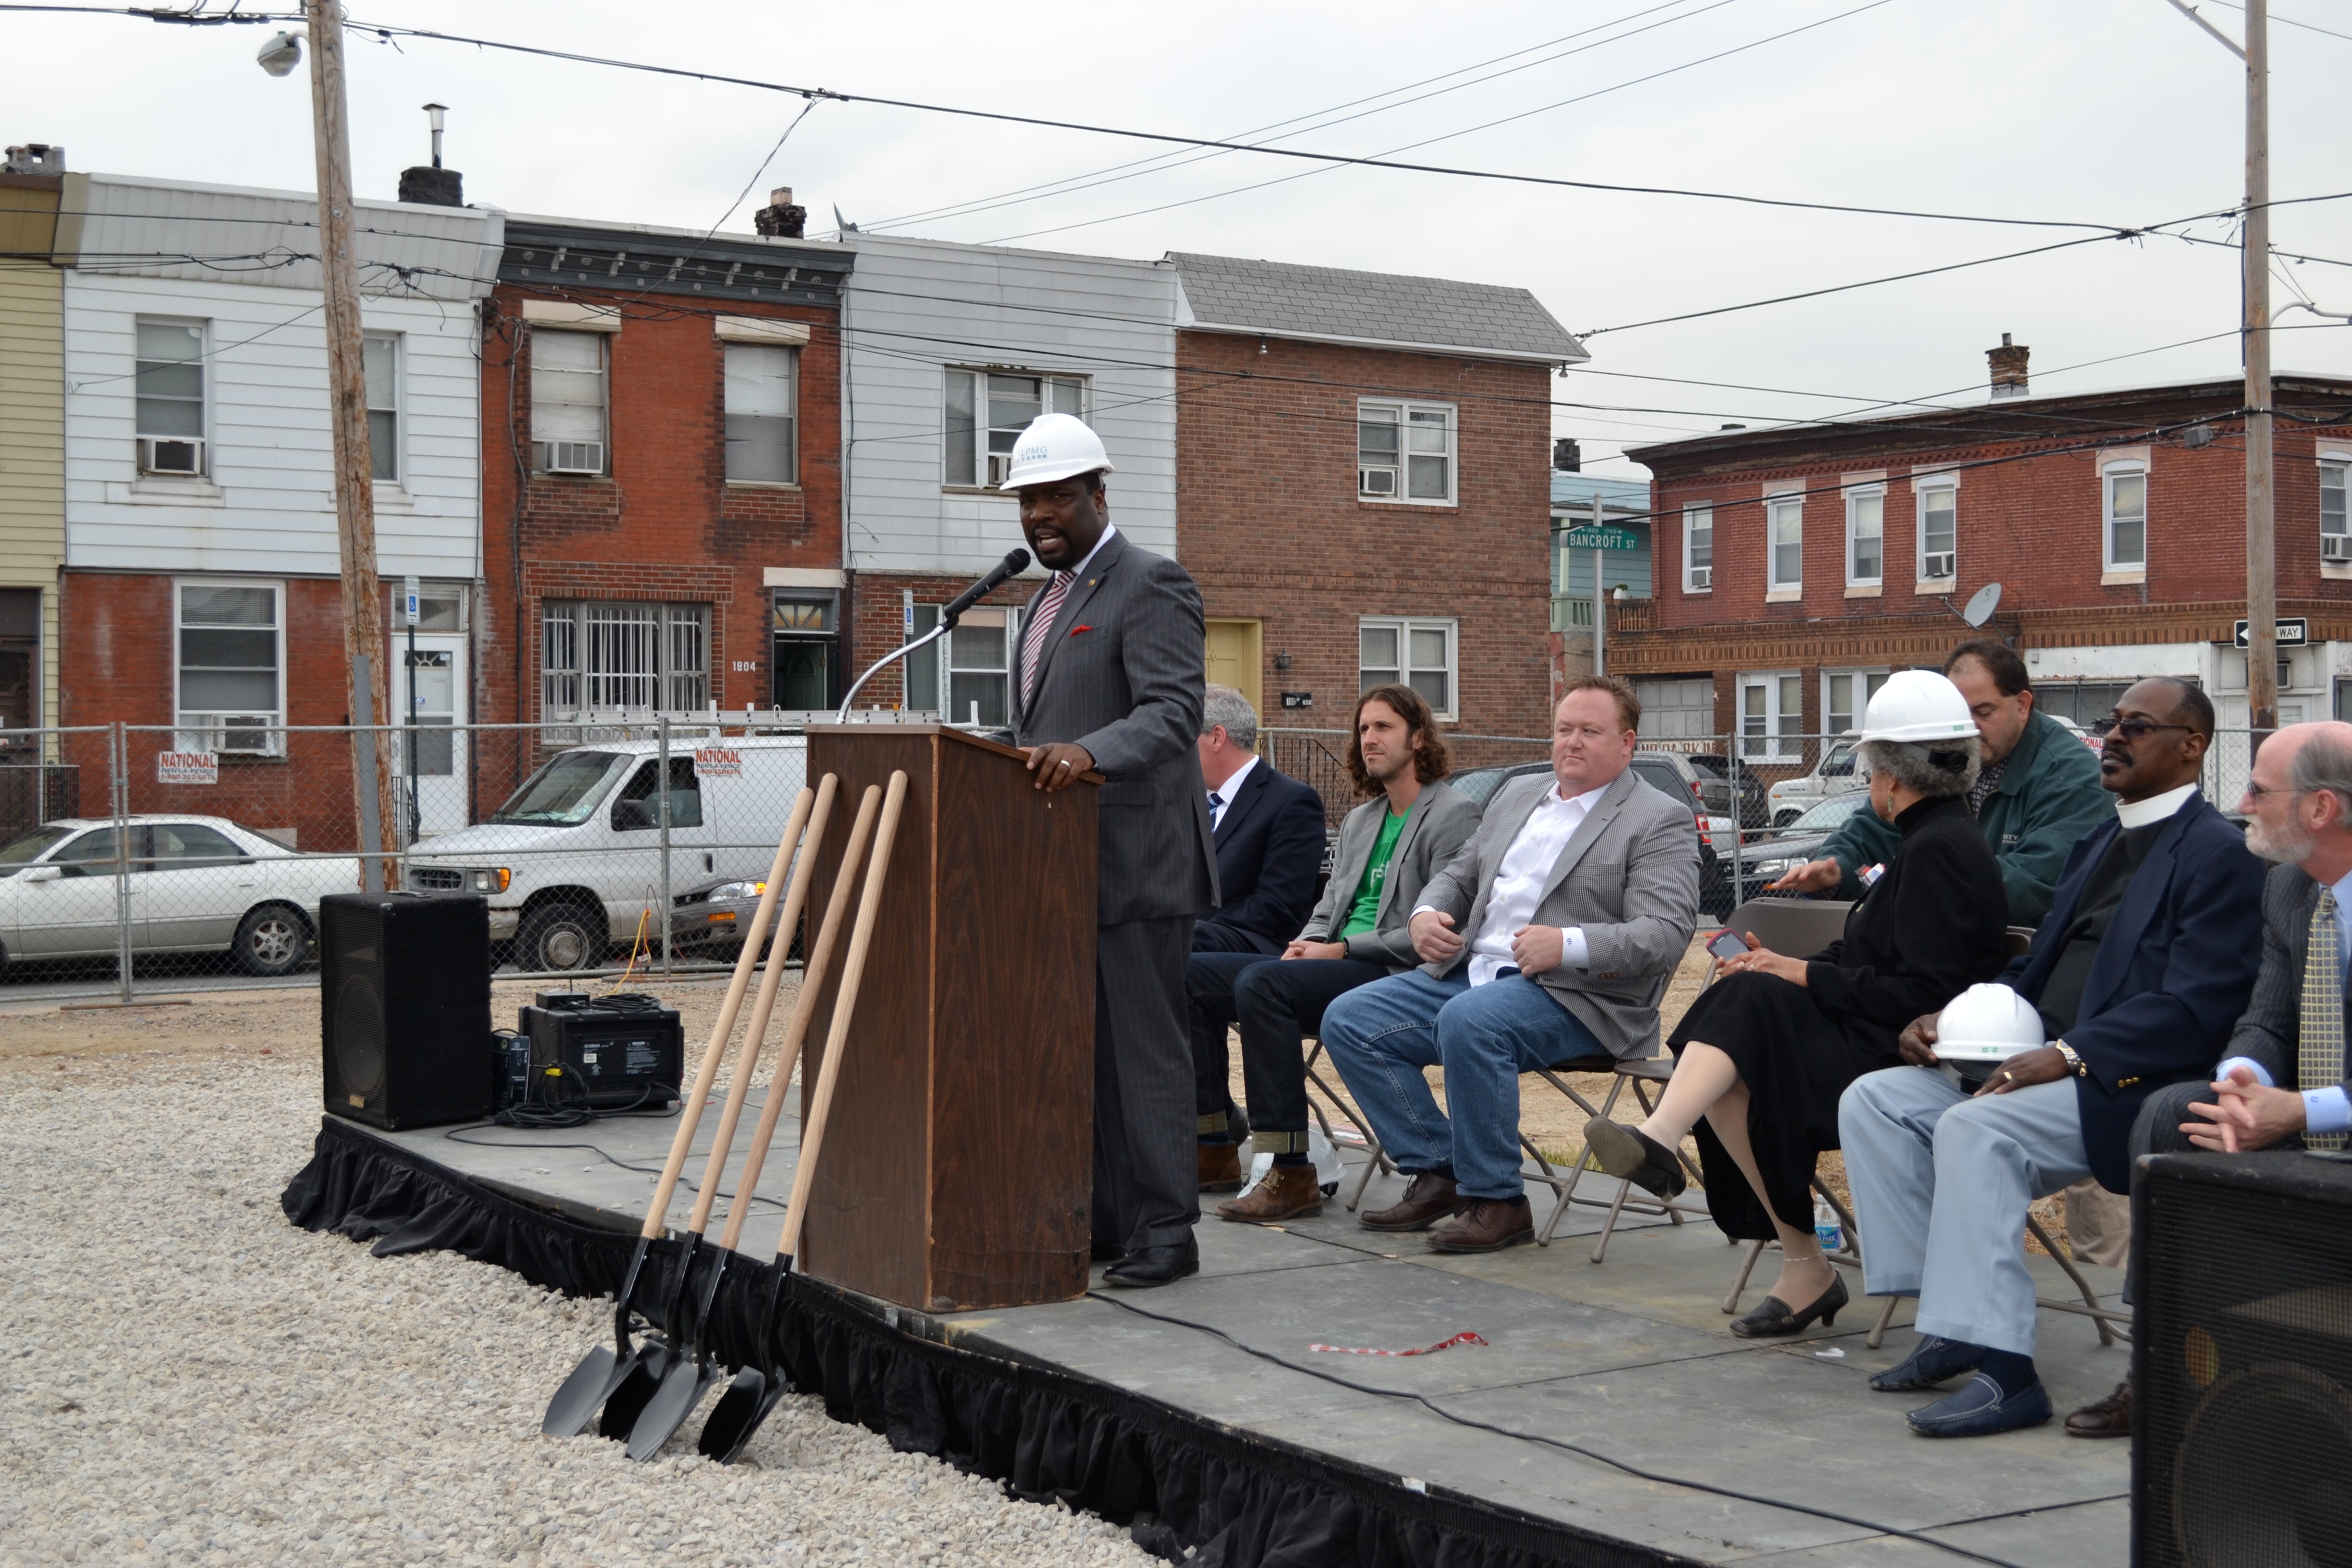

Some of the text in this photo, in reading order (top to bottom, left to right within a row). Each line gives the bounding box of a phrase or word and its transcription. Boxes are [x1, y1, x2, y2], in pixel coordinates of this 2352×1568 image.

[1021, 446, 1048, 456] LPMG
[1570, 533, 1635, 549] BANCROFT ST
[2279, 627, 2298, 638] WAY
[732, 661, 756, 672] 1804
[161, 753, 216, 768] NATIONAL
[696, 749, 742, 764] NATIONAL
